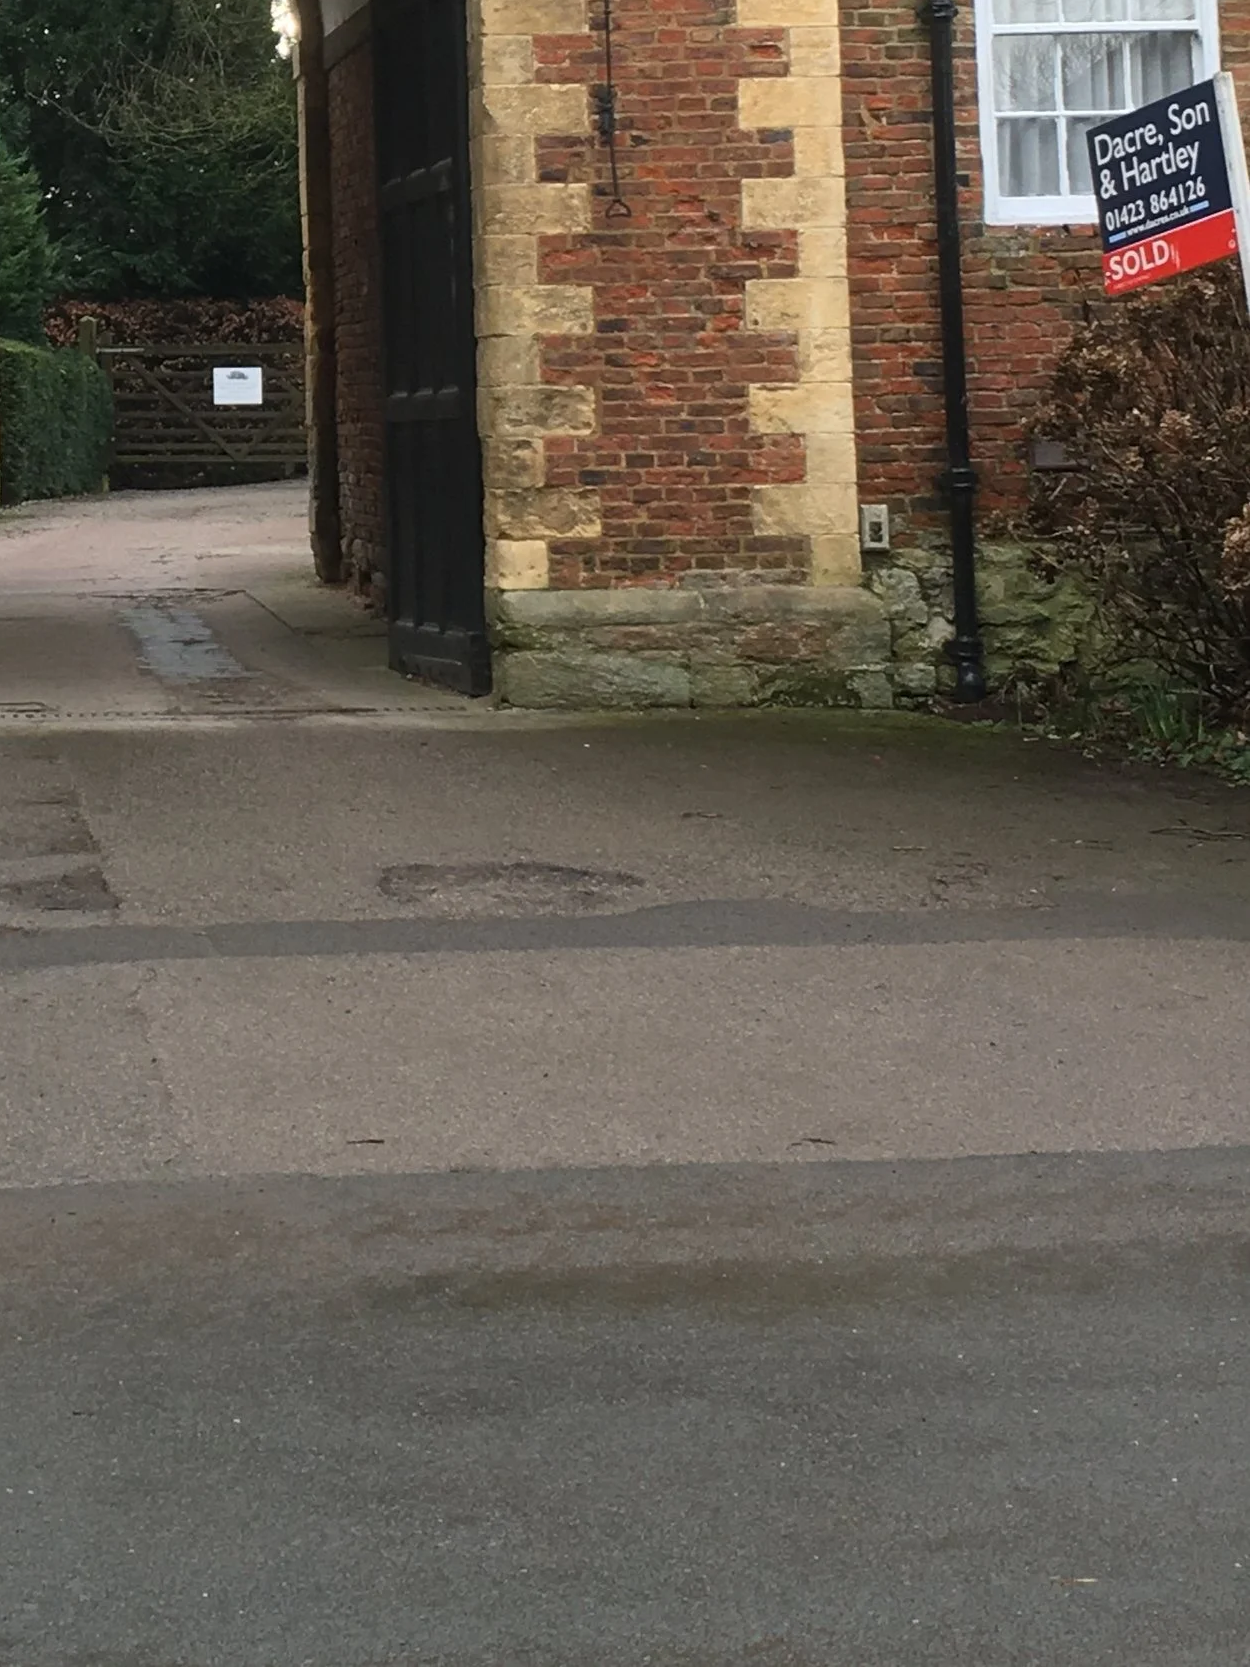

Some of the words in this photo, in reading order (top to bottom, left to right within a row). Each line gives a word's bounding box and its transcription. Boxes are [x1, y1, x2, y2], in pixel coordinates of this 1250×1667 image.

[1094, 123, 1163, 166] Dacre,
[1167, 101, 1210, 135] Son
[1100, 169, 1118, 200] &
[1120, 141, 1200, 191] Hartley
[1105, 200, 1145, 231] 01423
[1150, 176, 1206, 214] 864126
[1109, 240, 1170, 280] SOLD
